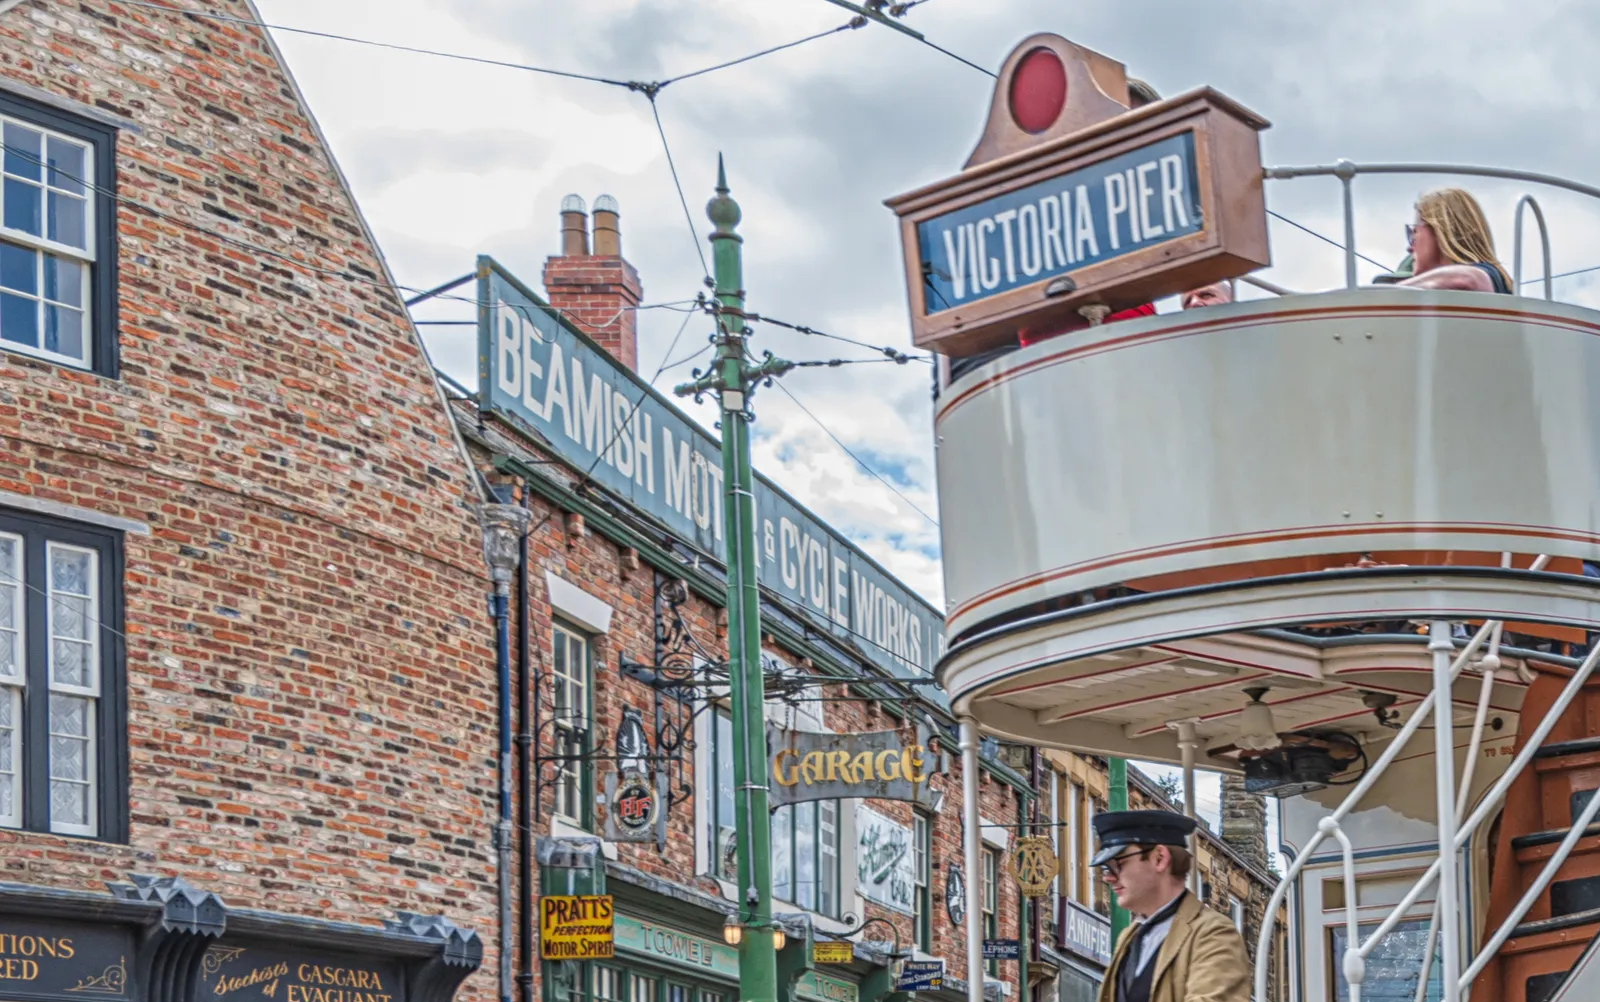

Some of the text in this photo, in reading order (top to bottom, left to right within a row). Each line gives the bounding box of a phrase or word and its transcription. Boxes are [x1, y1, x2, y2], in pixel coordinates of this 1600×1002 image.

[943, 154, 1189, 300] VICTORIA PIER
[498, 298, 921, 677] BEAMISH MOT & CYCLE WORKS
[773, 745, 926, 786] GARAGE
[544, 939, 577, 956] MOTOR
[981, 945, 1018, 954] LEPHONE
[1067, 912, 1111, 957] ANNFIEL
[213, 961, 288, 998] Stockists of
